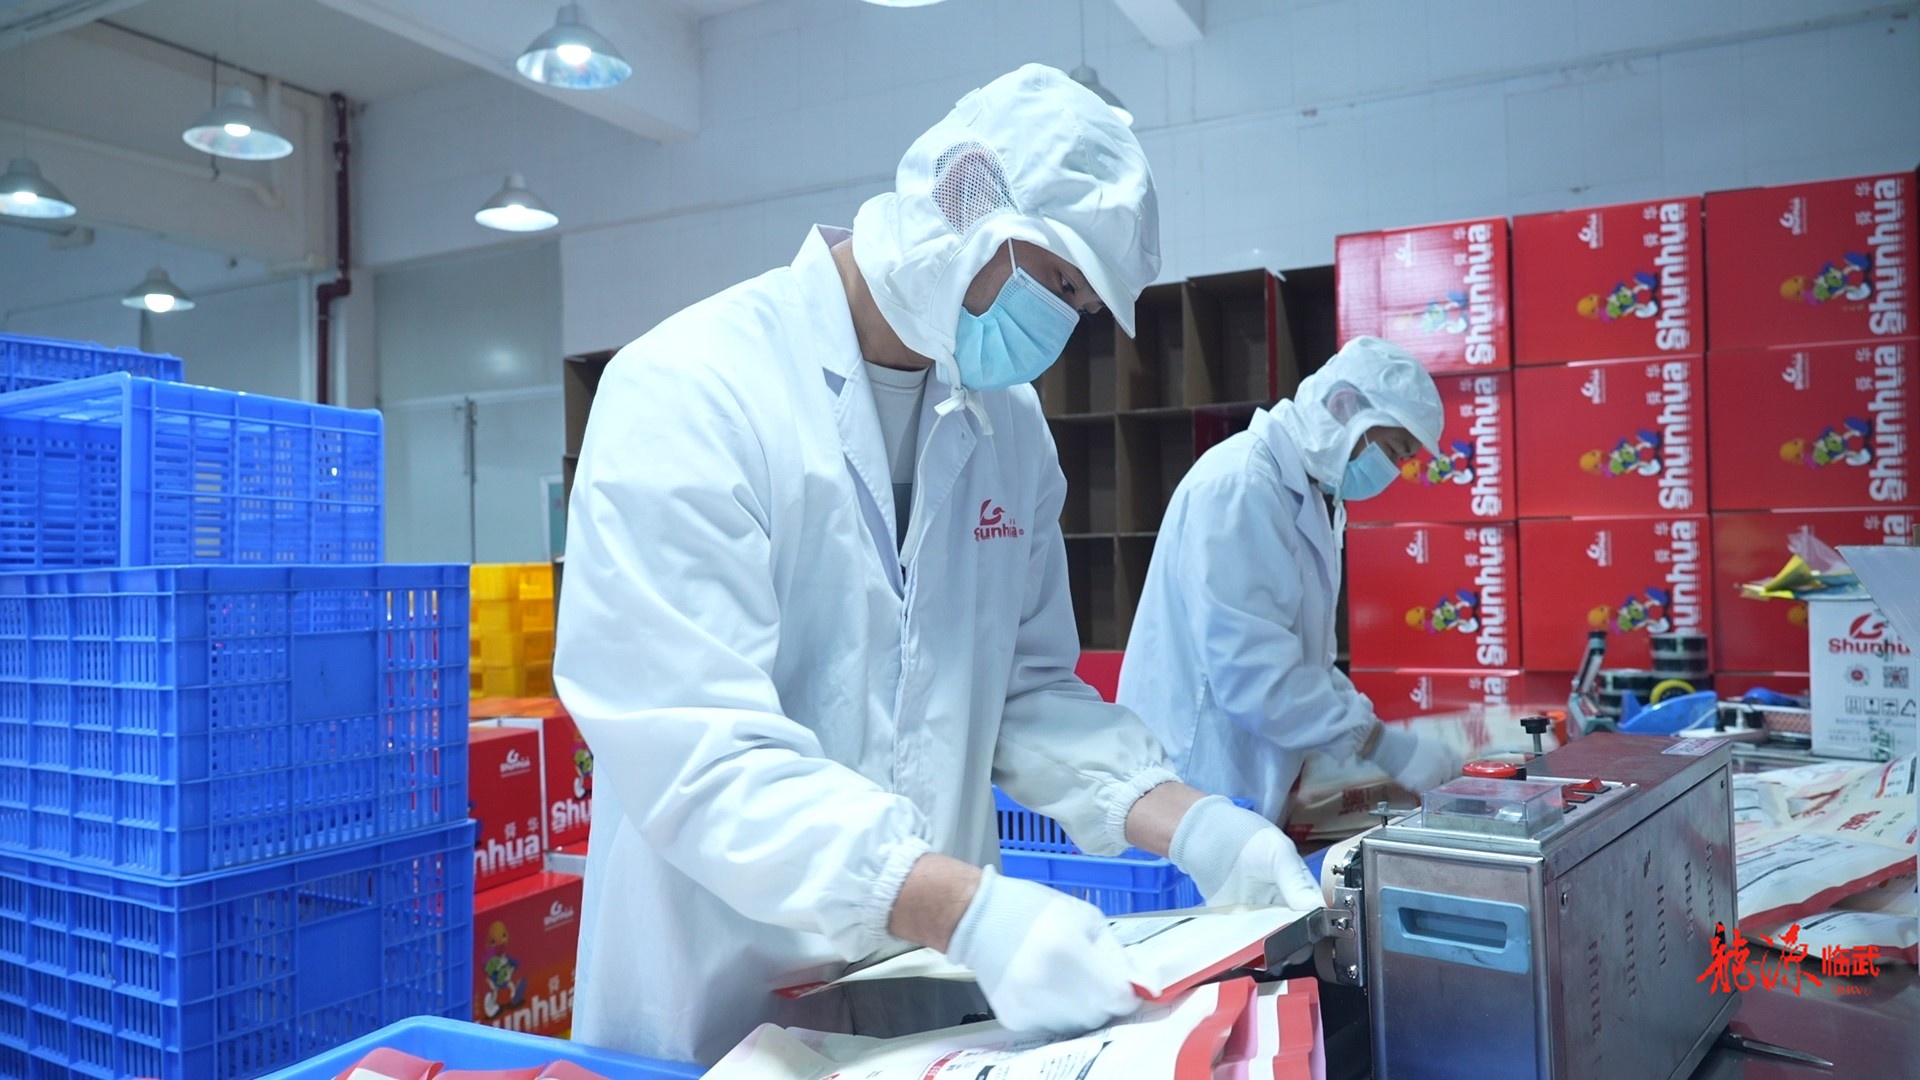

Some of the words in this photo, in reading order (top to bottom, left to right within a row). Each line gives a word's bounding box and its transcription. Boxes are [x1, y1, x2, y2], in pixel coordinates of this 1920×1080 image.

[1463, 224, 1494, 364] Shunhua
[1654, 203, 1688, 350] Shunhua
[1867, 179, 1905, 335] Shunhua
[1469, 377, 1501, 516] Shunhua
[1657, 362, 1691, 509] Shunhua
[1868, 345, 1906, 501] Shunhua
[1474, 527, 1506, 666] Shunhua
[1665, 520, 1700, 635] unhua
[474, 834, 540, 876] nhua
